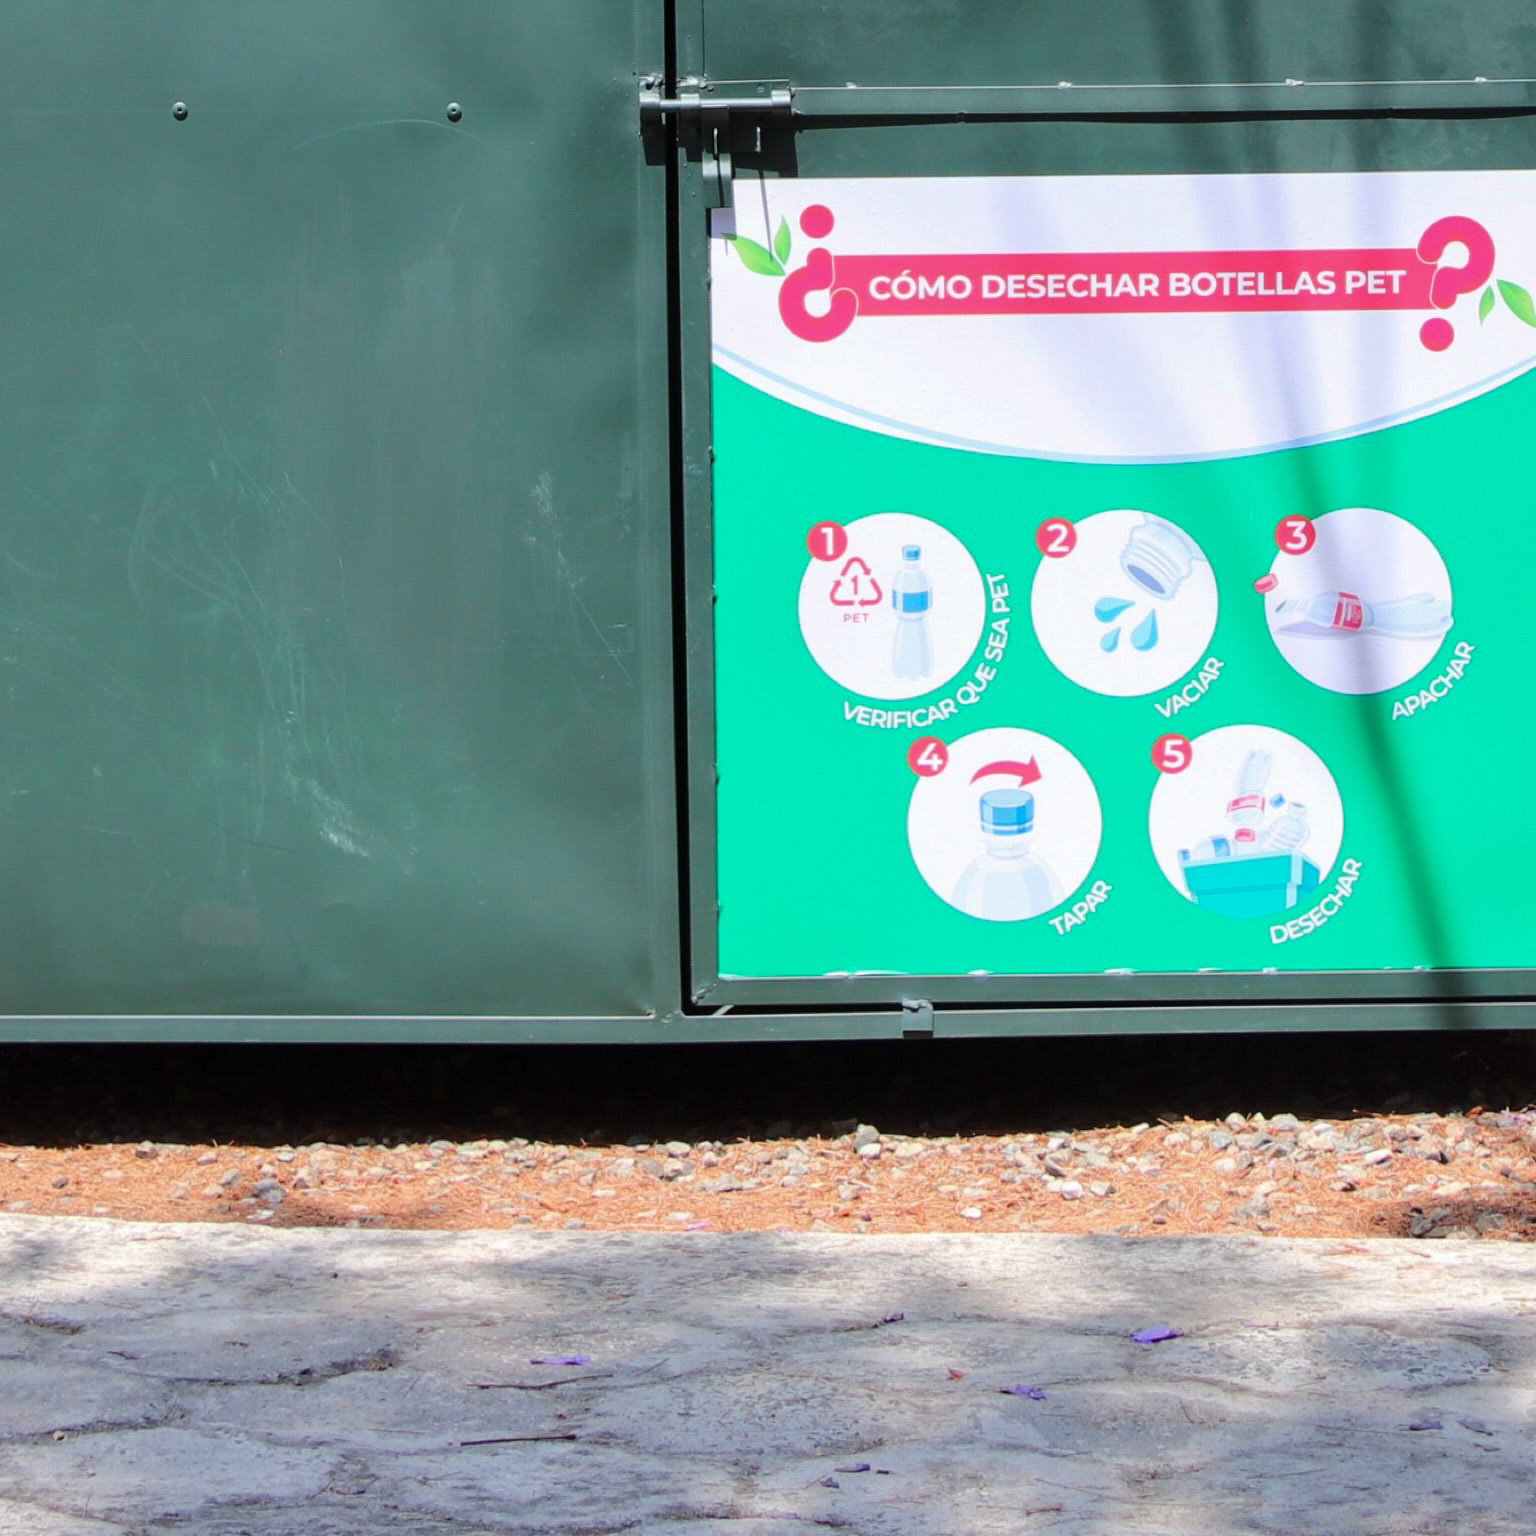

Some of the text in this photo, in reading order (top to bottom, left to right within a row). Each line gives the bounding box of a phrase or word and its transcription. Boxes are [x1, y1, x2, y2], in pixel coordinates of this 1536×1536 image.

[981, 273, 1160, 299] DESECHAR
[1168, 271, 1337, 297] BOTELLAS
[820, 526, 835, 557] 1
[1046, 523, 1070, 553] 2
[1285, 520, 1308, 551] 3
[842, 612, 870, 624] PET
[843, 573, 1011, 729] VERIFICAR QUE SEA PET
[1154, 657, 1225, 719] VACIAR
[1391, 641, 1475, 721] APACHAR
[916, 742, 944, 772] 4
[1161, 739, 1186, 769] 5
[1048, 880, 1113, 936] TAPAR
[1269, 858, 1363, 944] DESECHAR
